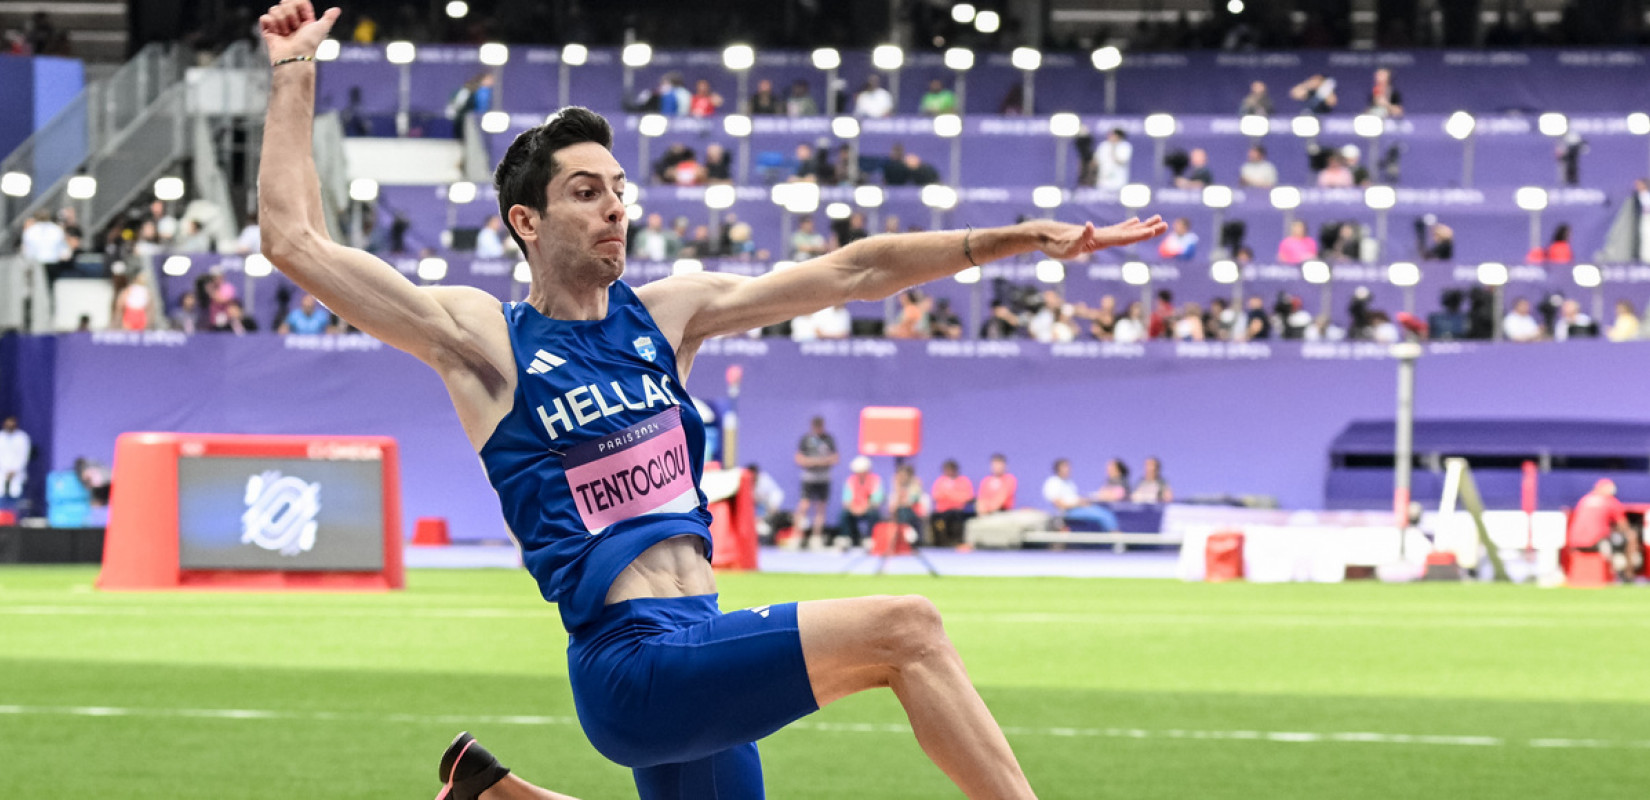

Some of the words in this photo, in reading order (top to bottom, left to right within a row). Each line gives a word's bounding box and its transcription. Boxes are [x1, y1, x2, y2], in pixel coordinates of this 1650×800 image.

[598, 432, 633, 452] PARIS
[634, 422, 659, 439] 2024
[576, 444, 685, 515] TENTOGLOU
